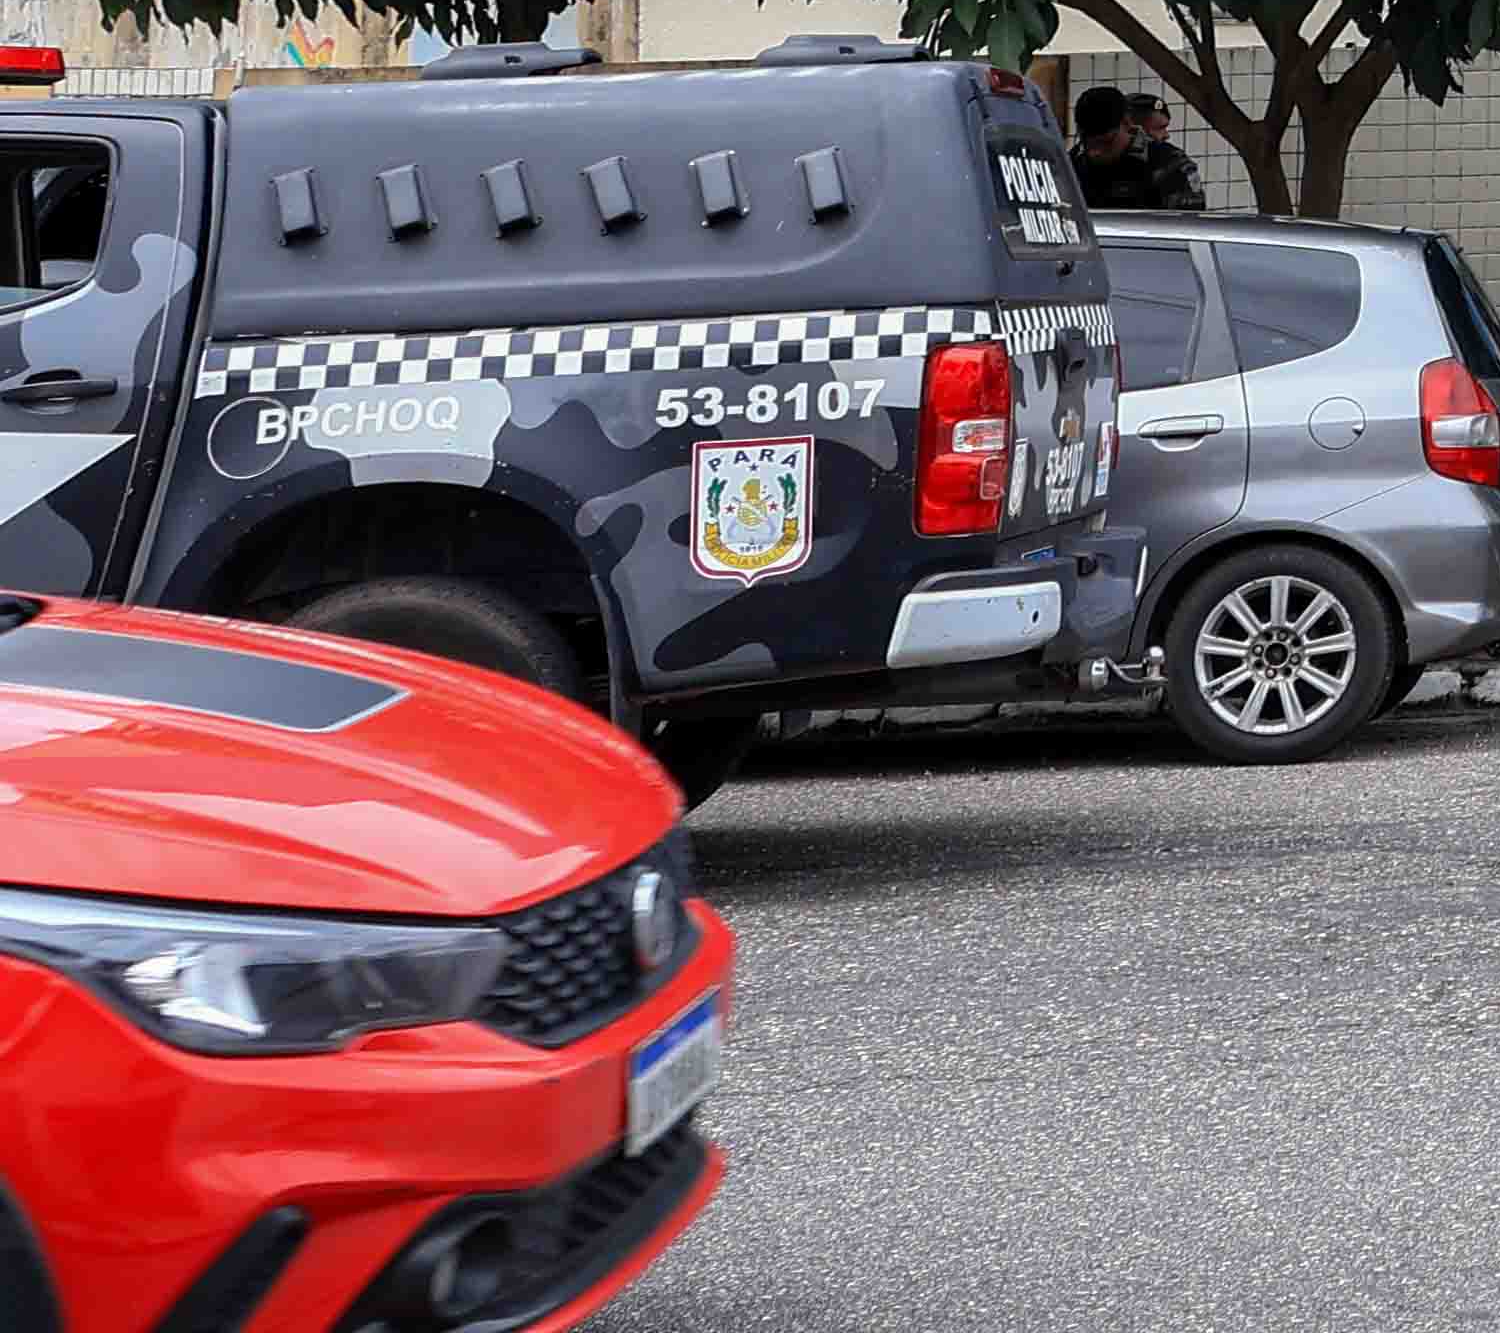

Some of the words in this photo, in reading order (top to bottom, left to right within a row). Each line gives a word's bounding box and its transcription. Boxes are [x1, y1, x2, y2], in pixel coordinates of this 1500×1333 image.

[998, 148, 1061, 204] POLÍCIA
[255, 396, 460, 446] BPCHOQ
[655, 378, 885, 428] 53-8107
[707, 448, 800, 472] PARÁ
